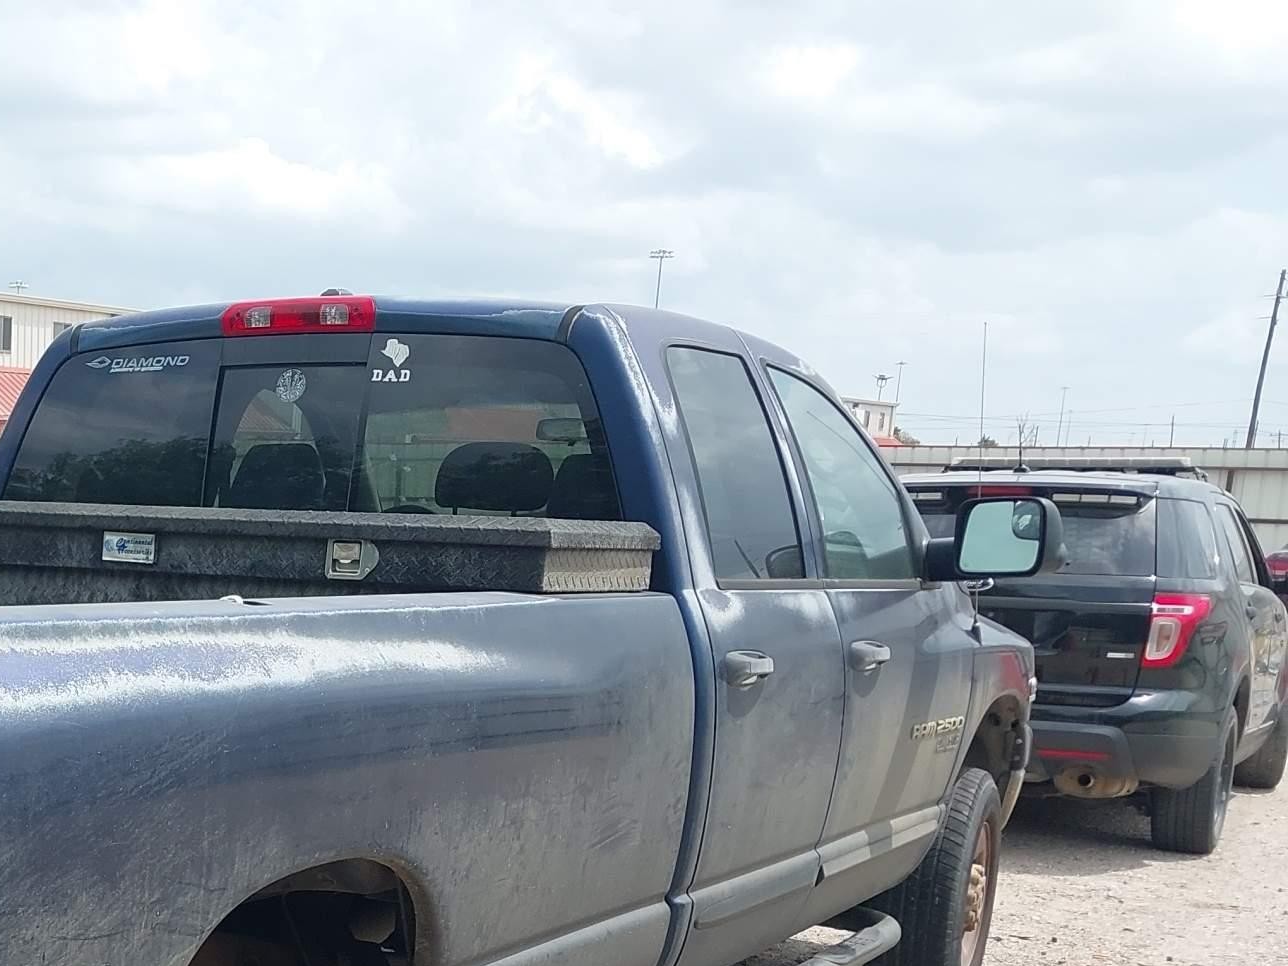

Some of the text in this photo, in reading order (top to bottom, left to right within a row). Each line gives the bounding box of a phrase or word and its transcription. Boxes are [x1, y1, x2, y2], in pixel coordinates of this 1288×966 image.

[112, 355, 190, 368] DIAMOND
[371, 369, 411, 382] DAD
[912, 716, 965, 739] RAM 2500
